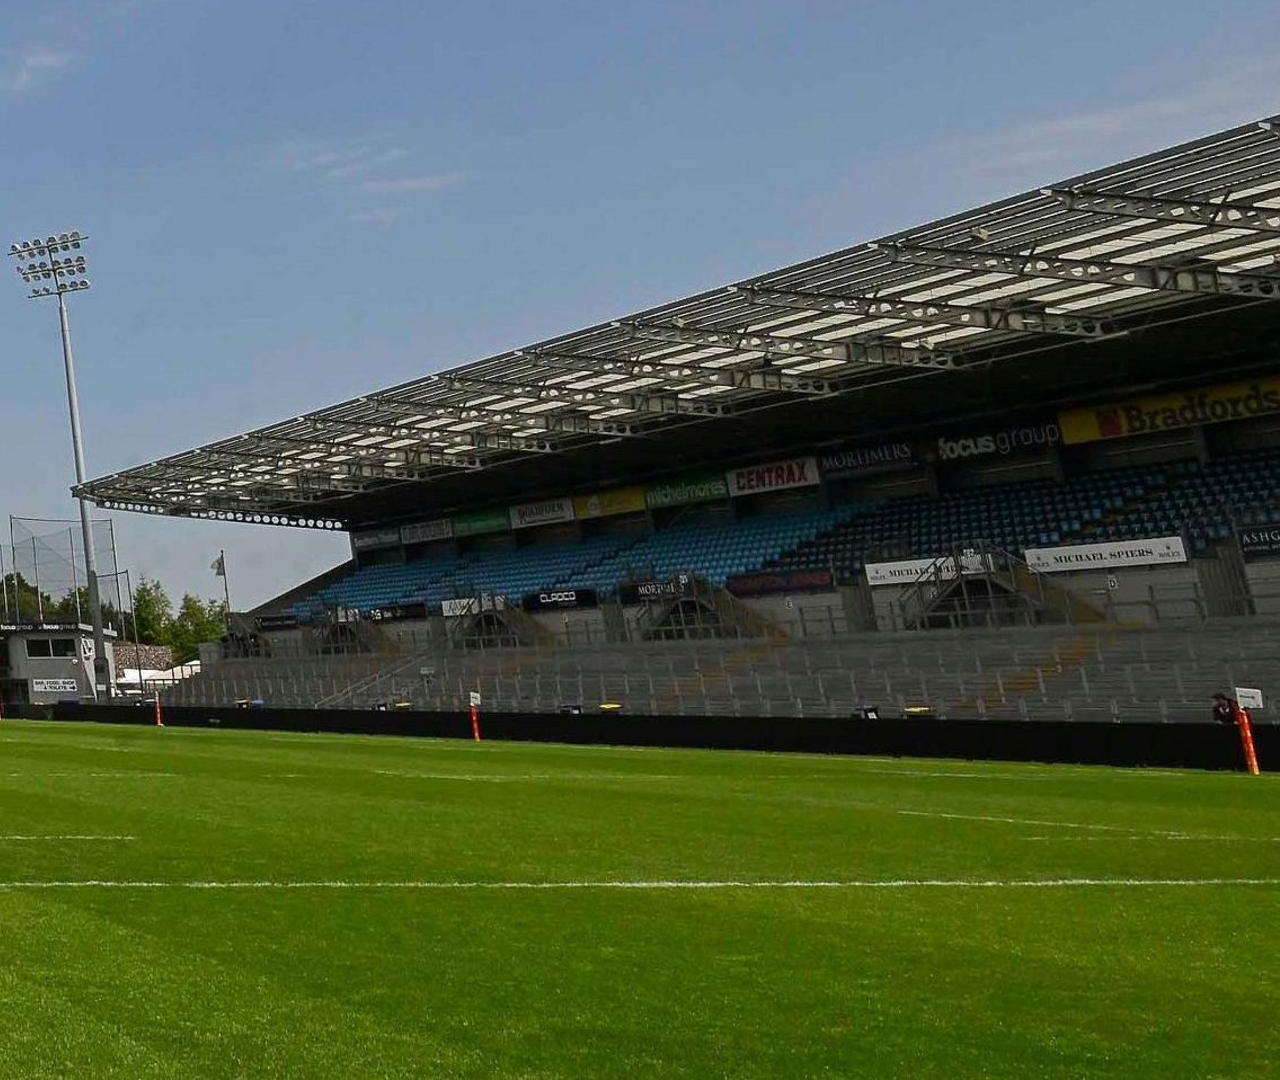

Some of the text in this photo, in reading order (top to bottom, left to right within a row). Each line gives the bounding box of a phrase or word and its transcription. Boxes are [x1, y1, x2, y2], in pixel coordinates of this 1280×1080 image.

[1126, 384, 1280, 432] Bradfords
[647, 476, 727, 506] michelmores
[736, 463, 808, 491] CENTRAX
[1053, 552, 1107, 564] MICHAEL
[1109, 547, 1154, 560] SPIERS
[540, 591, 576, 603] CLADCO
